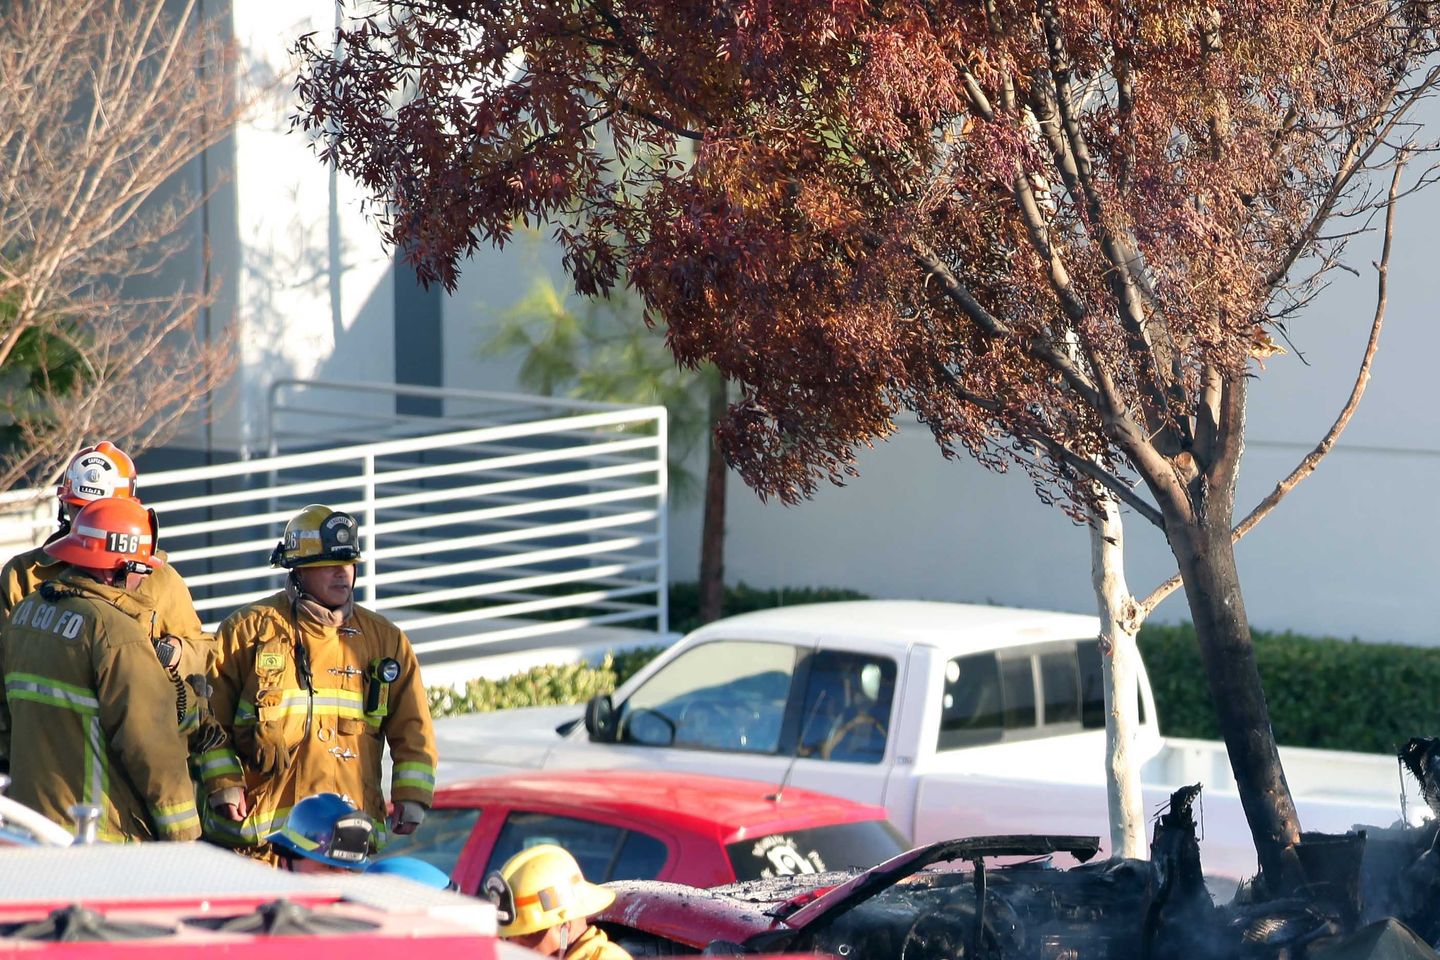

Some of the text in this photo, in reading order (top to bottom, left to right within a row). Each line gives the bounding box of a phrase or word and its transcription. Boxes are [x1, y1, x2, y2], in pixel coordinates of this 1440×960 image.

[110, 533, 138, 554] 156
[12, 600, 84, 639] LA CO FD
